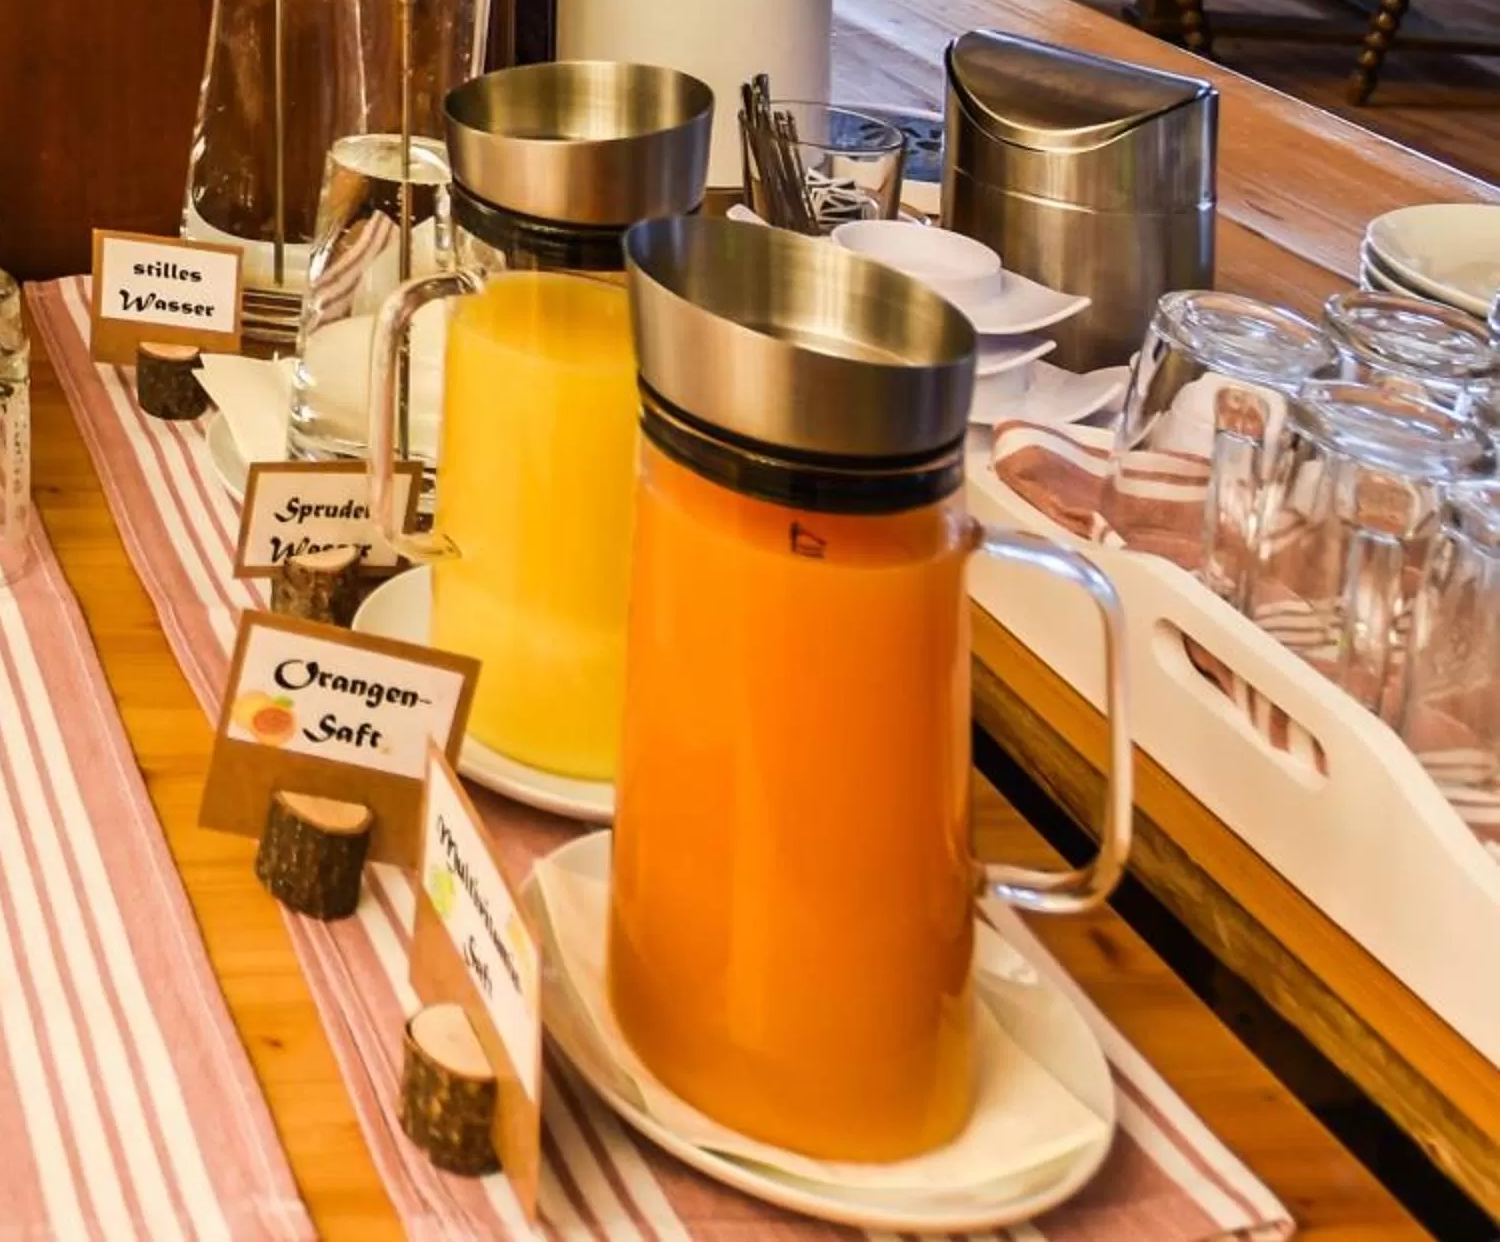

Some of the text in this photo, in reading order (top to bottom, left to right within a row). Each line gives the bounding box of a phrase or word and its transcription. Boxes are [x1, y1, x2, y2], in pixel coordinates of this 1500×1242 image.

[133, 261, 203, 283] stilles
[119, 289, 216, 317] Wasser
[274, 658, 432, 709] Orangen-
[302, 713, 382, 748] Saft
